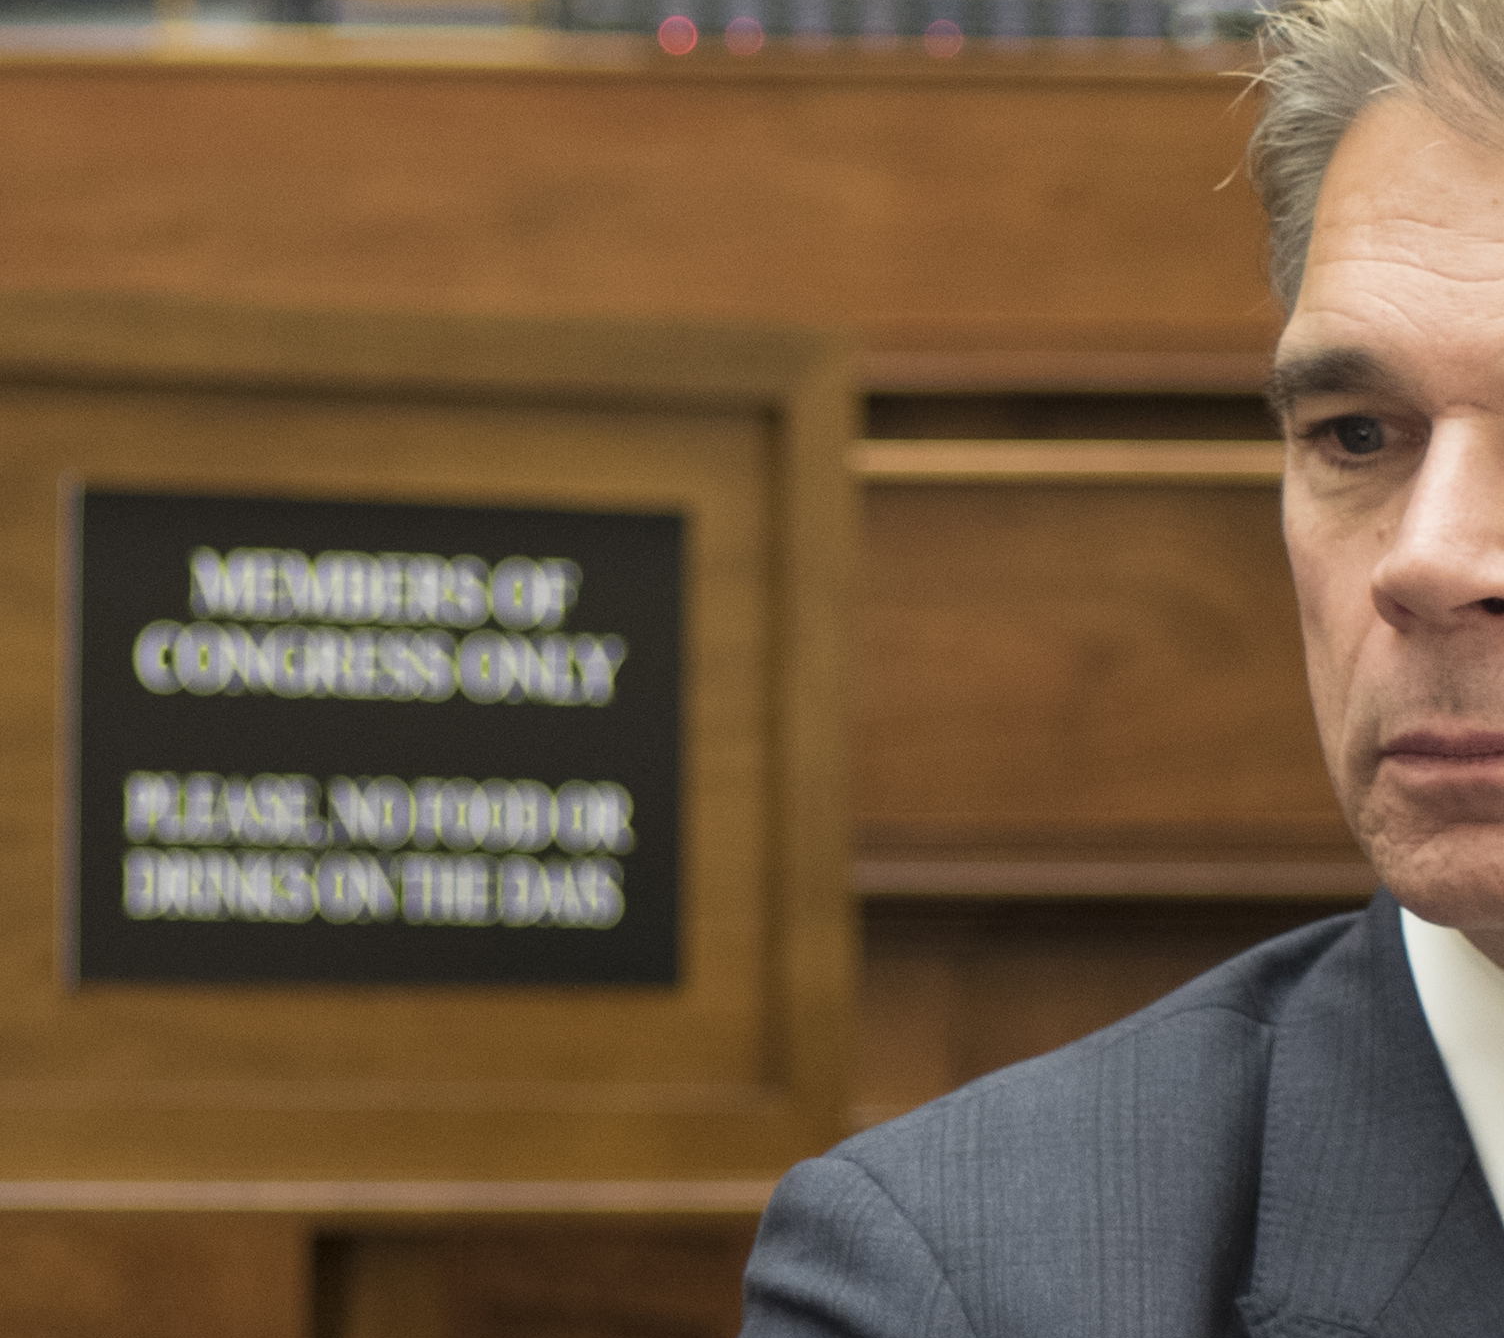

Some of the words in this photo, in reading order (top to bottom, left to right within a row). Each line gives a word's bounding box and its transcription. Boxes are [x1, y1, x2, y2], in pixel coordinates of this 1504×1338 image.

[190, 547, 491, 629] MEMBERS
[492, 555, 582, 630] OF
[134, 620, 458, 701] CONGRESS
[459, 629, 625, 706] ONLY
[328, 775, 414, 849] NO
[415, 778, 555, 852] FOOD
[554, 781, 635, 854] OR
[124, 847, 317, 921] DRINKS
[317, 850, 398, 924] ON
[400, 852, 498, 926] THE
